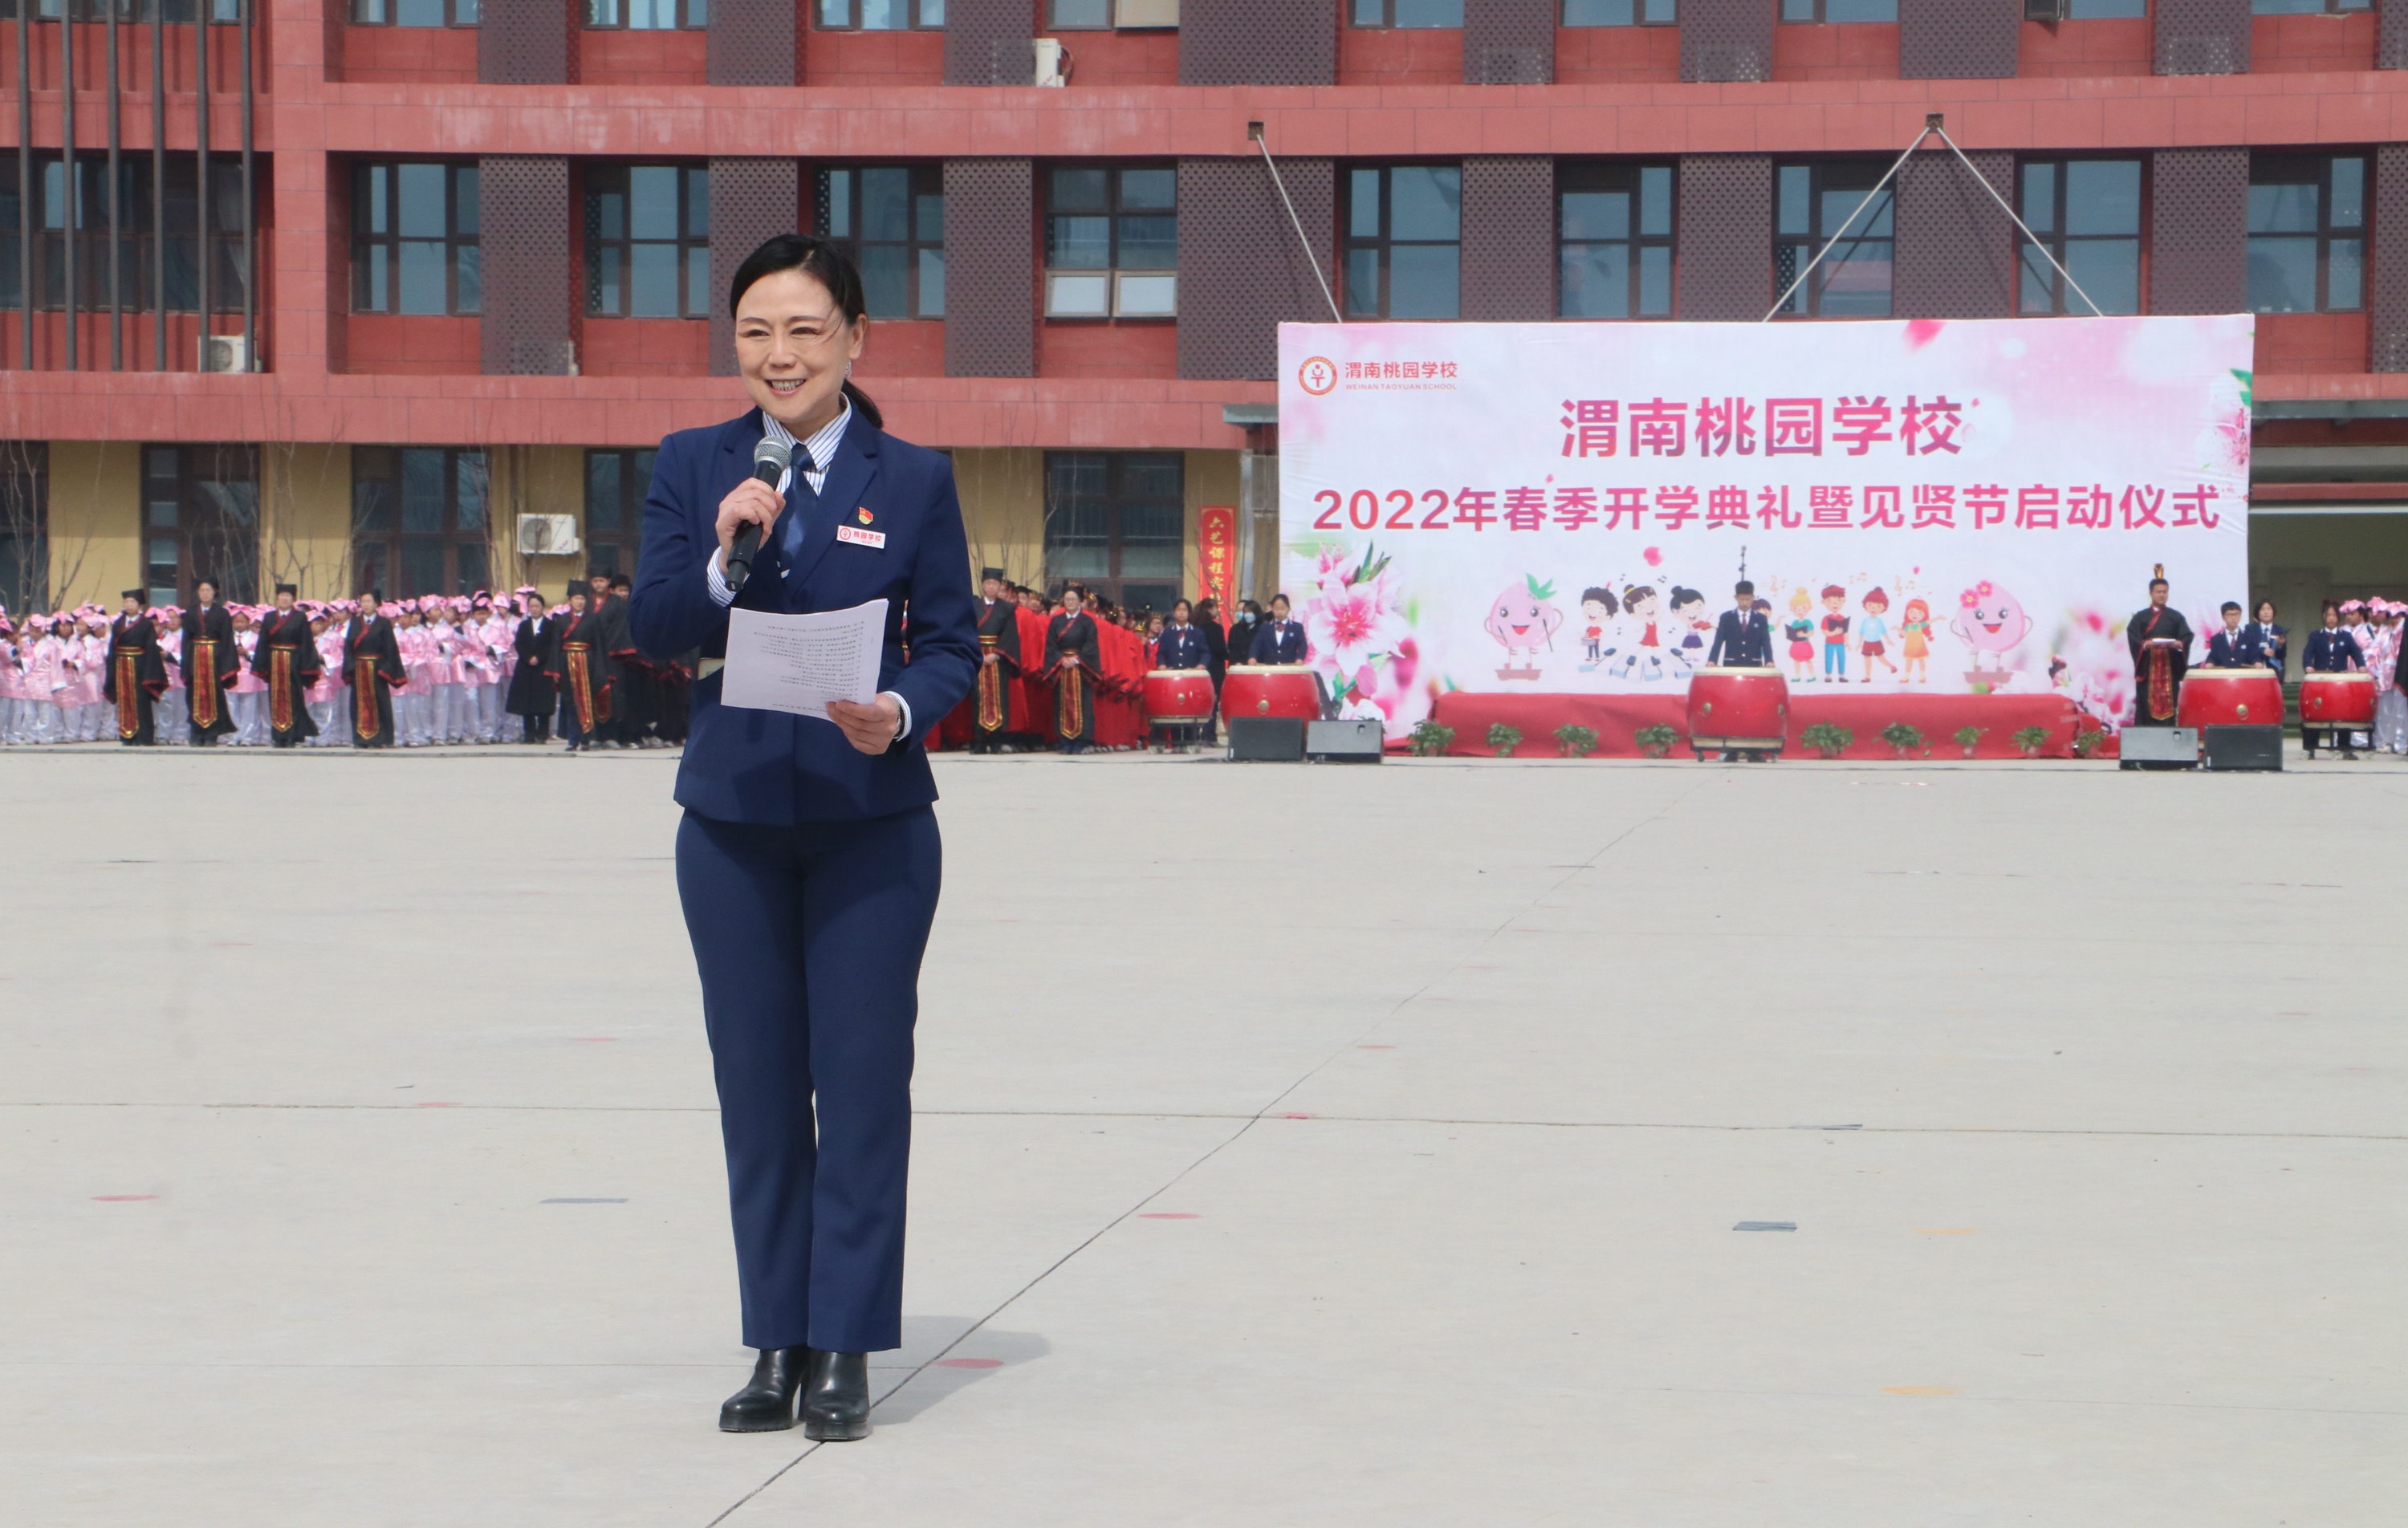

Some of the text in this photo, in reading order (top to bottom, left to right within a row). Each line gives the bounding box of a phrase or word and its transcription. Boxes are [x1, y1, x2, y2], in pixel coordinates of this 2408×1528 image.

[1345, 362, 1458, 379] 渭南桃园学校
[1561, 396, 1962, 458] 渭南桃园学校
[1314, 484, 2219, 532] 2022年春季开学典礼暨见贤节启动仪式
[853, 530, 881, 542] 桃园学校
